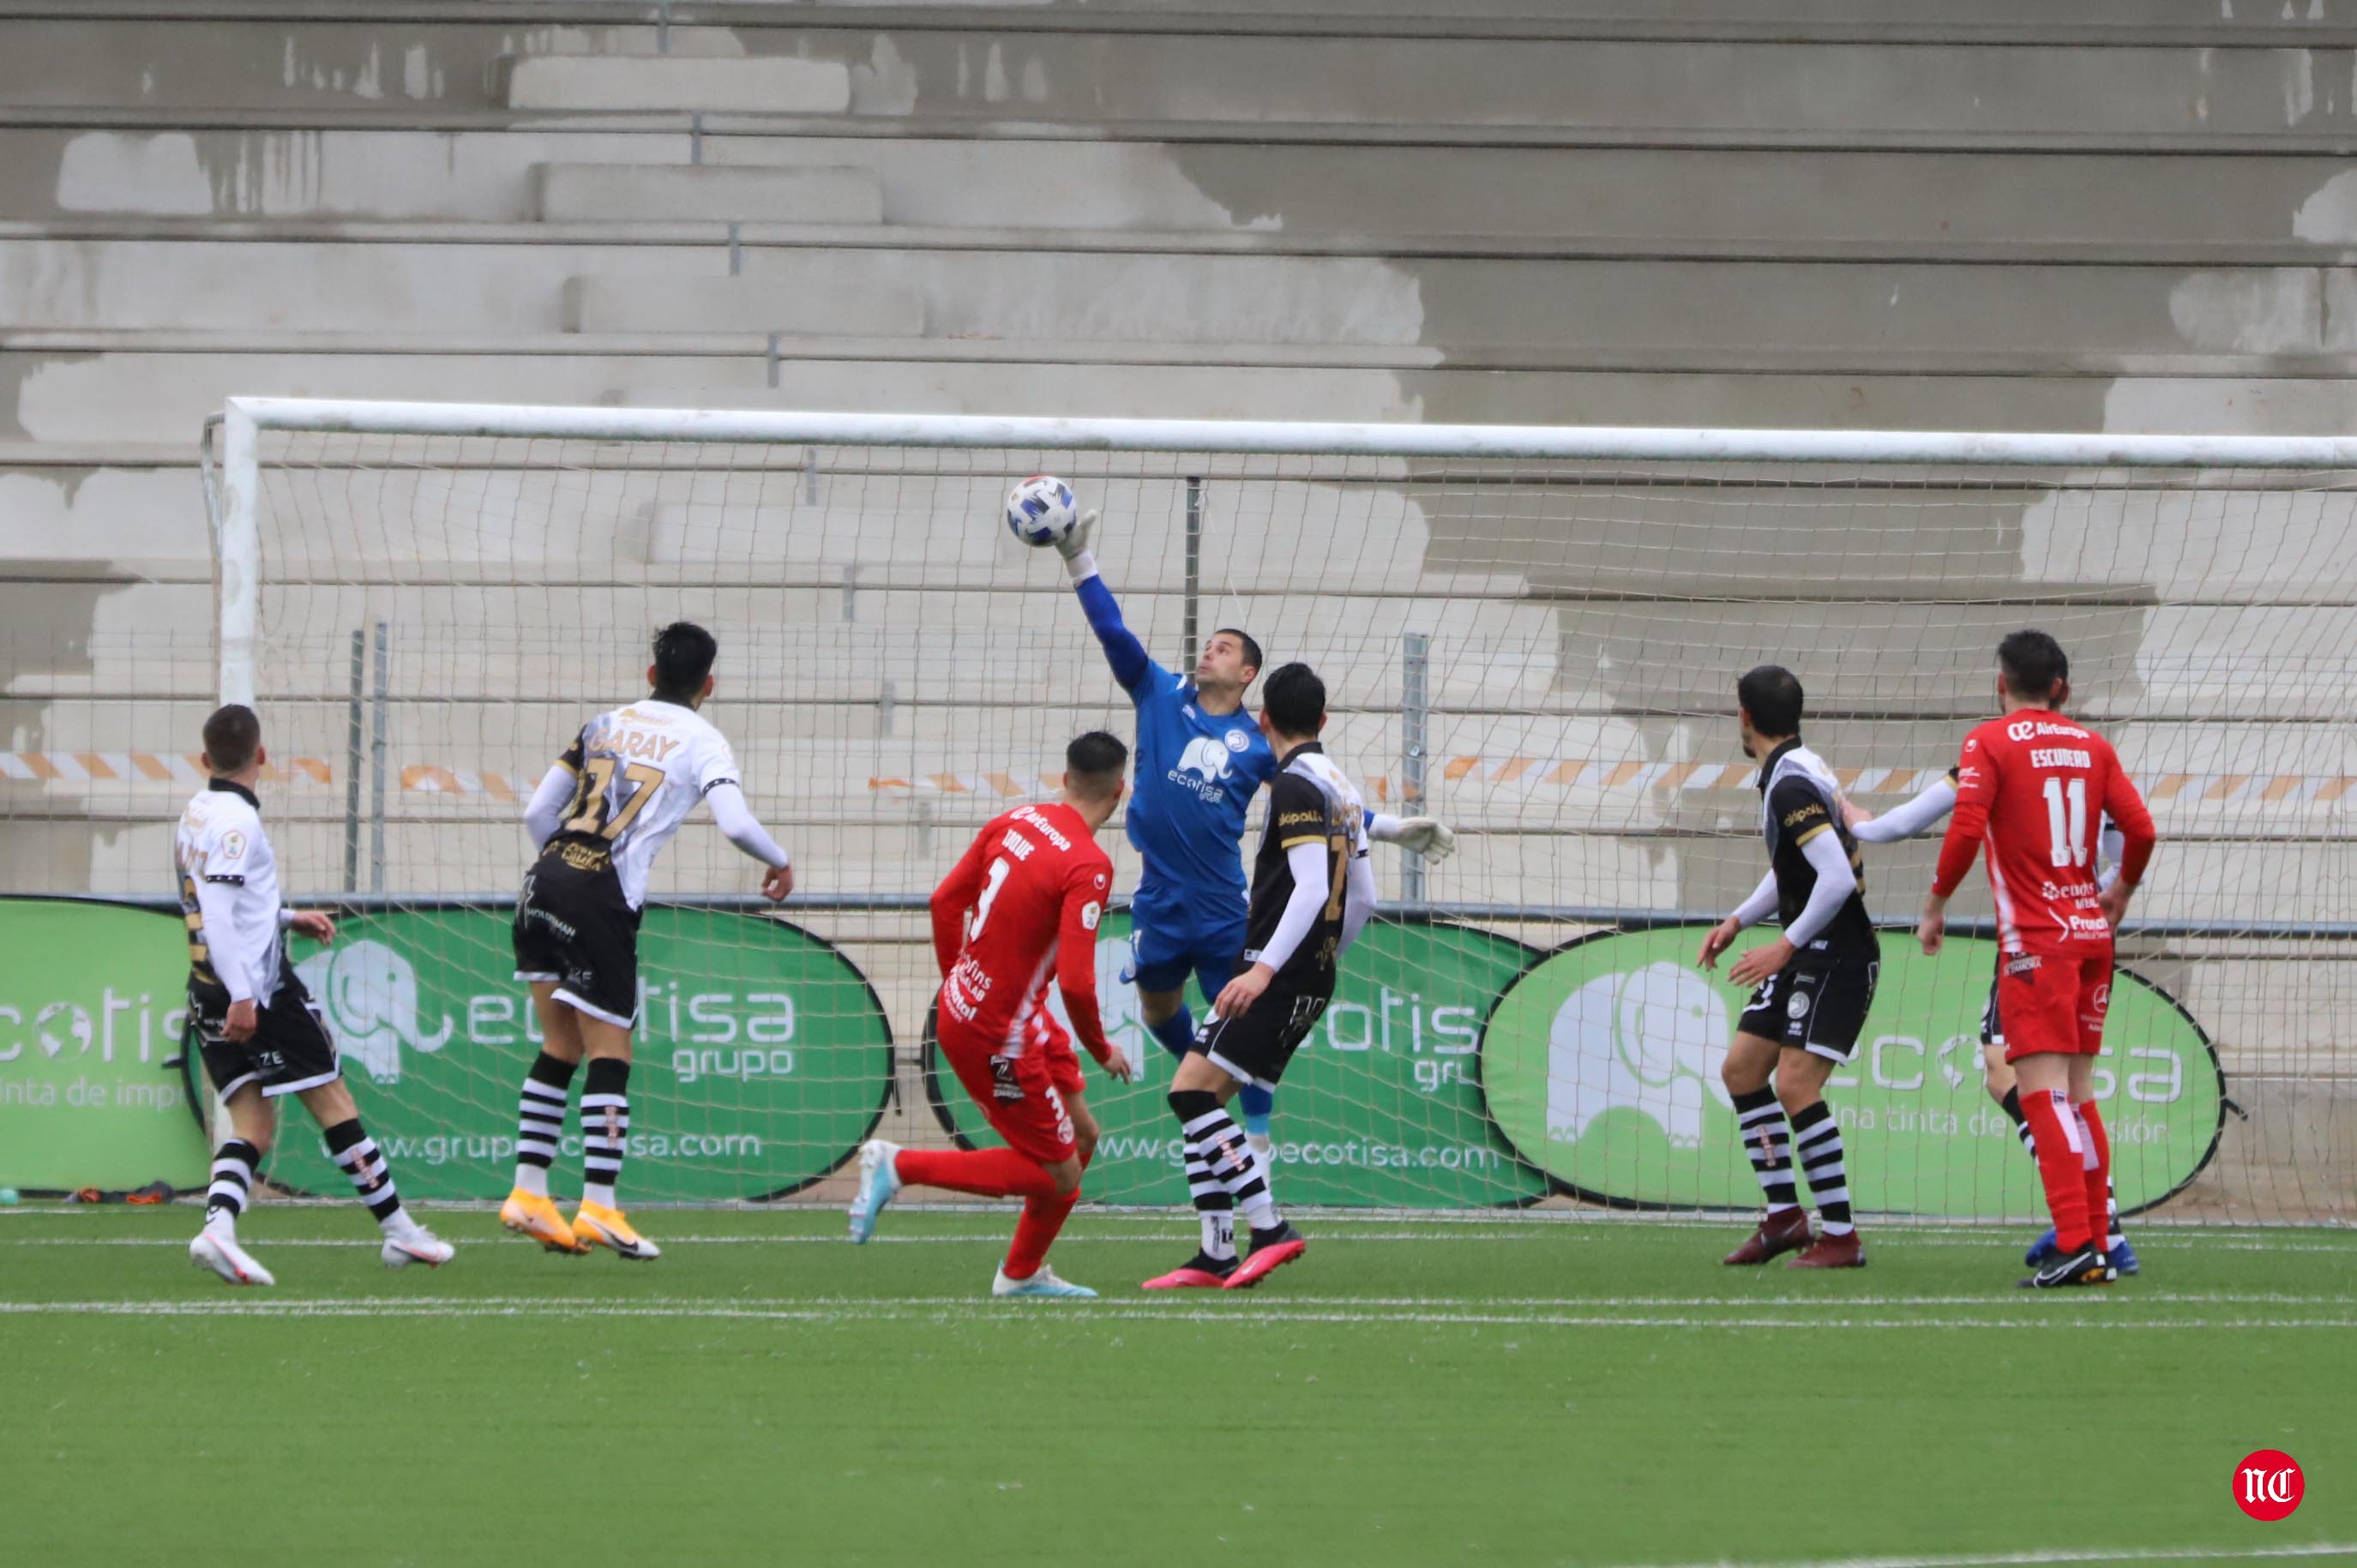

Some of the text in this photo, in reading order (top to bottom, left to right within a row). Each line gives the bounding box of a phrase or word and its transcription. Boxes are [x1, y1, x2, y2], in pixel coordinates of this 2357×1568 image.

[589, 727, 680, 762] GARAY
[2030, 748, 2091, 768] ESCUDERO
[564, 755, 666, 841] 17
[1167, 769, 1224, 799] ecotisa
[2042, 777, 2089, 868] 11
[970, 856, 1010, 943] 3
[468, 976, 795, 1044] etisa
[672, 1048, 794, 1083] grupo
[0, 1077, 55, 1106] nta
[67, 1075, 106, 1106] de
[1044, 1084, 1065, 1121] 3
[1886, 1105, 1958, 1137] tinta
[1967, 1106, 2007, 1138] de
